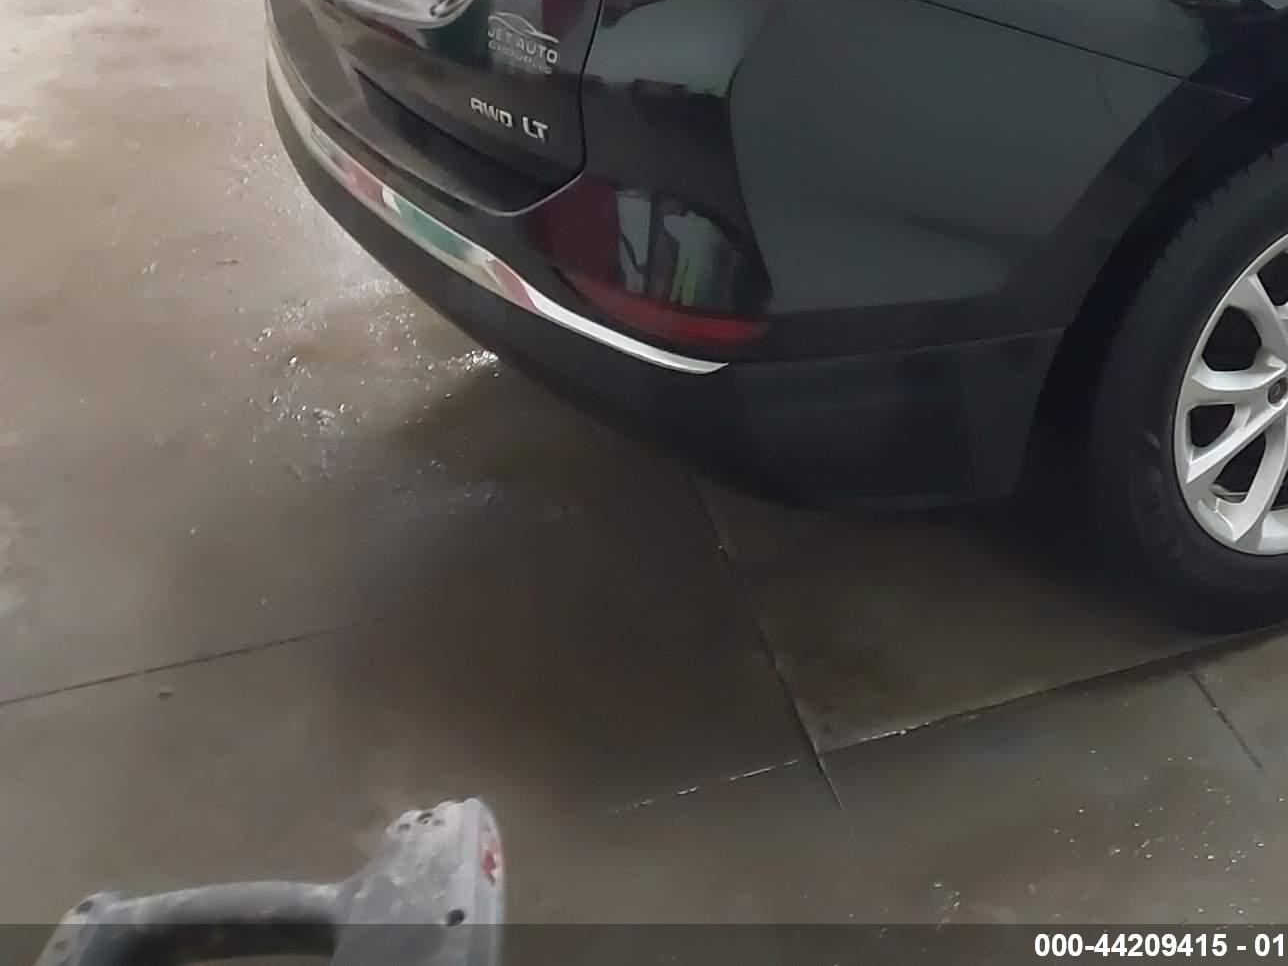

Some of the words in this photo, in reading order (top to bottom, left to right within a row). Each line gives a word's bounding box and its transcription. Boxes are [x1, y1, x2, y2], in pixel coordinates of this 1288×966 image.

[487, 27, 513, 43] JET
[516, 37, 558, 64] AUTO
[470, 97, 513, 128] AWD
[522, 116, 549, 140] LT
